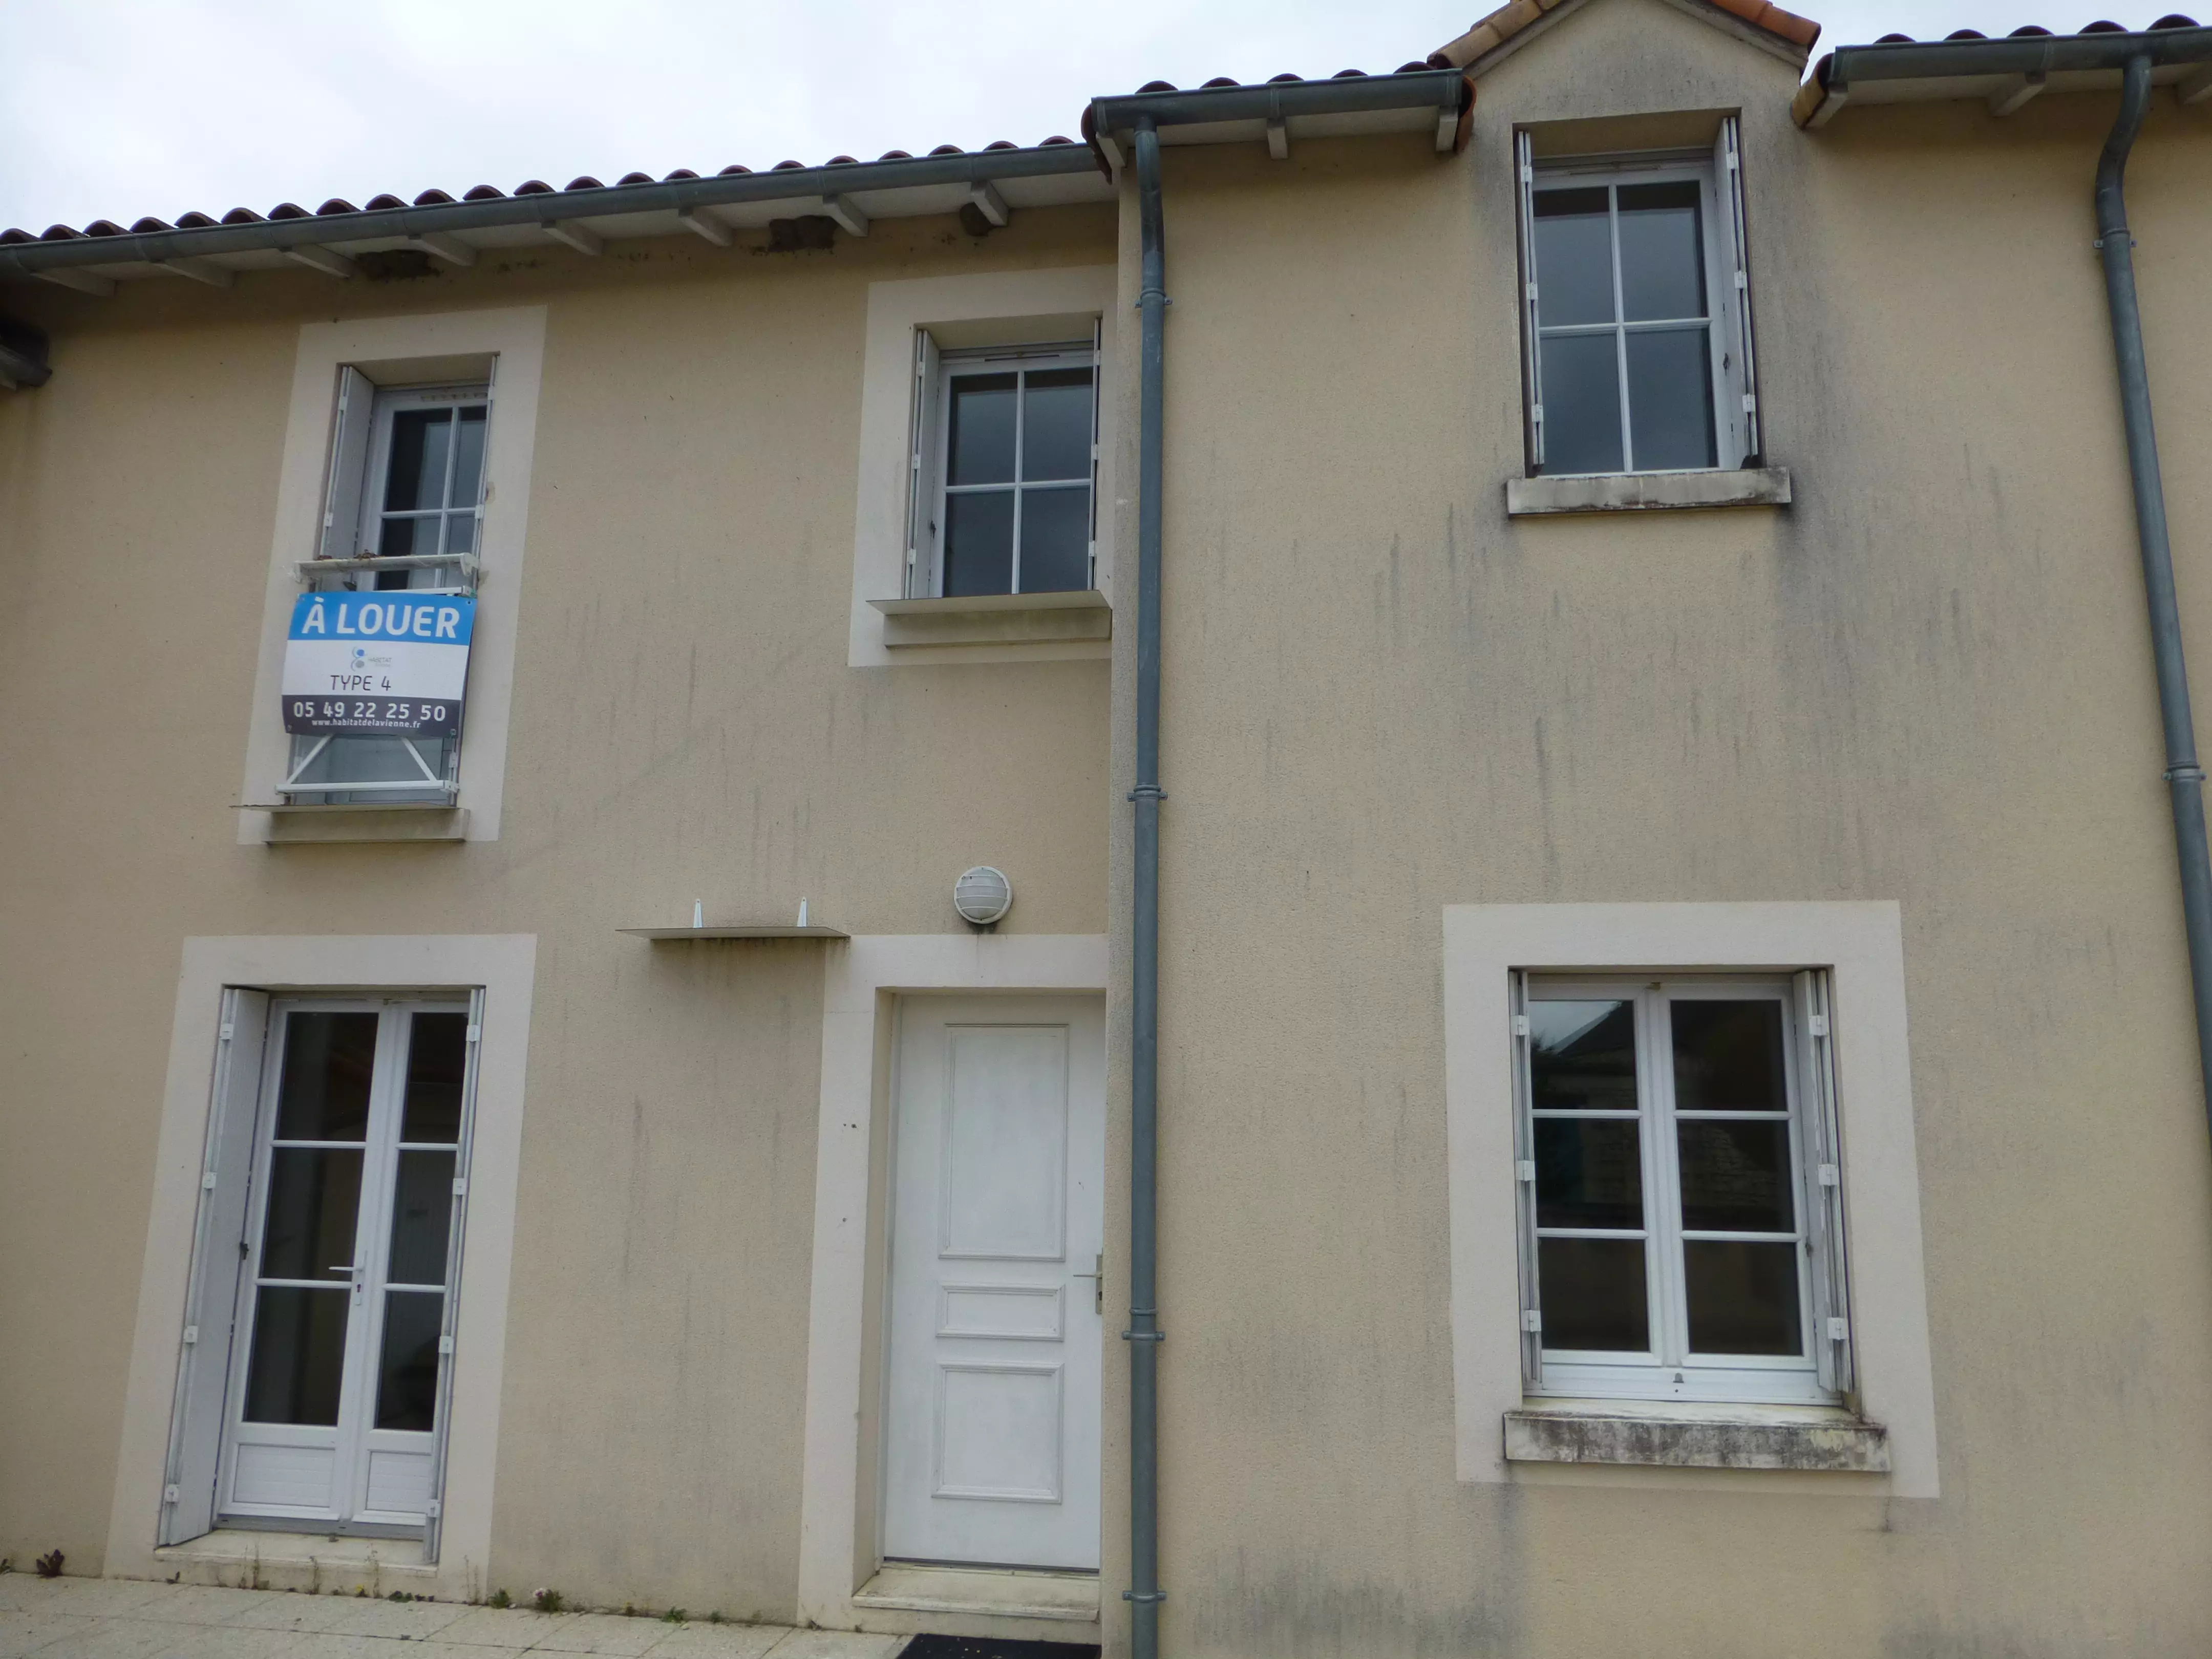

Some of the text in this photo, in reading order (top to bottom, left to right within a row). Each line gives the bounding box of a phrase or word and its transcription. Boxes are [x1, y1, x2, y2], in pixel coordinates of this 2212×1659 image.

[302, 596, 460, 639] À LOUER
[330, 675, 392, 691] TYPE 4
[293, 701, 446, 721] 05 49 22 25 50
[311, 718, 421, 728] www.habitatdelavienne.fr
